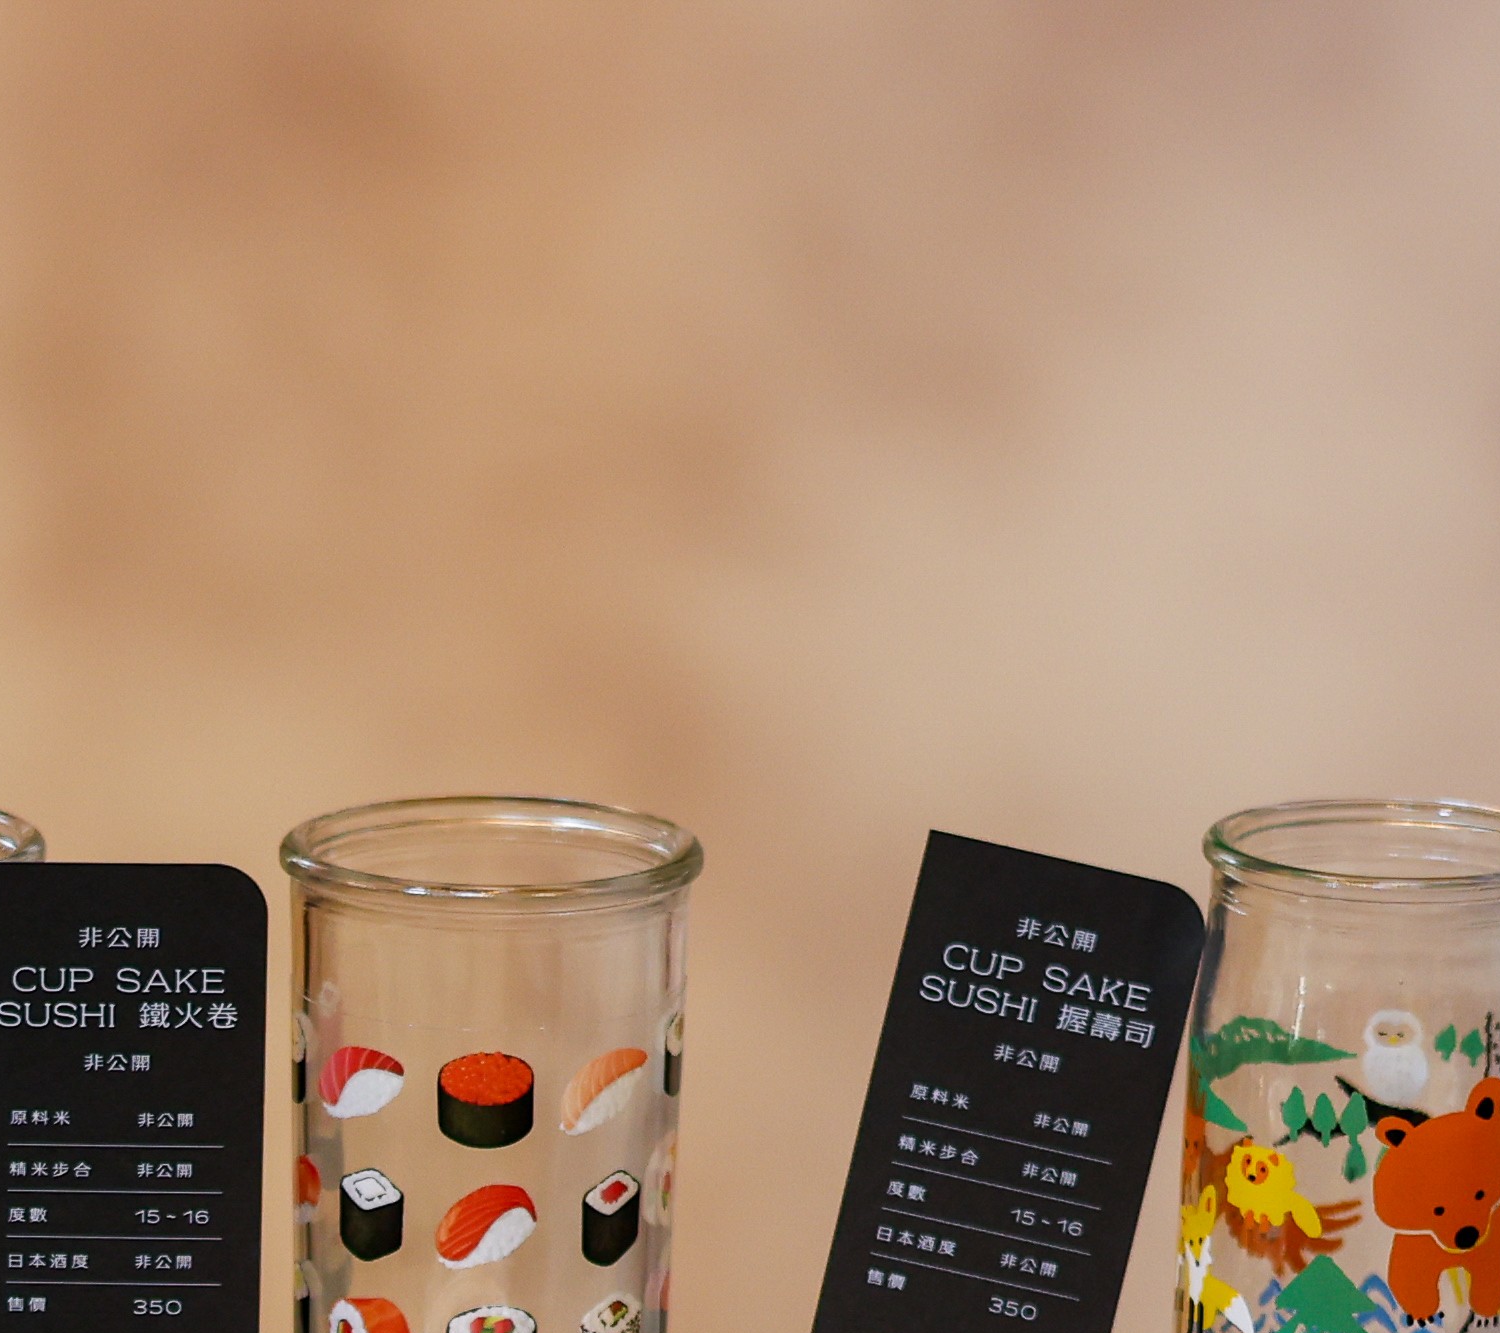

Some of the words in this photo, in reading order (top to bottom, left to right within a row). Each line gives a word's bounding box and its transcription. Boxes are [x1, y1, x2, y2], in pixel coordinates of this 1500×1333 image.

[79, 927, 159, 948] 非公開
[1017, 918, 1097, 952] 非公開
[13, 967, 93, 992] CUP
[117, 968, 224, 993] SAKE
[943, 945, 1024, 980] CUP
[1043, 965, 1151, 1012] SAKE
[920, 976, 1038, 1023] SUSHI
[1056, 1004, 1156, 1049] 握壽司
[85, 1054, 150, 1071] 非公開
[994, 1044, 1060, 1072] 非公開
[134, 1300, 181, 1314] 350
[989, 1297, 1036, 1320] 350
